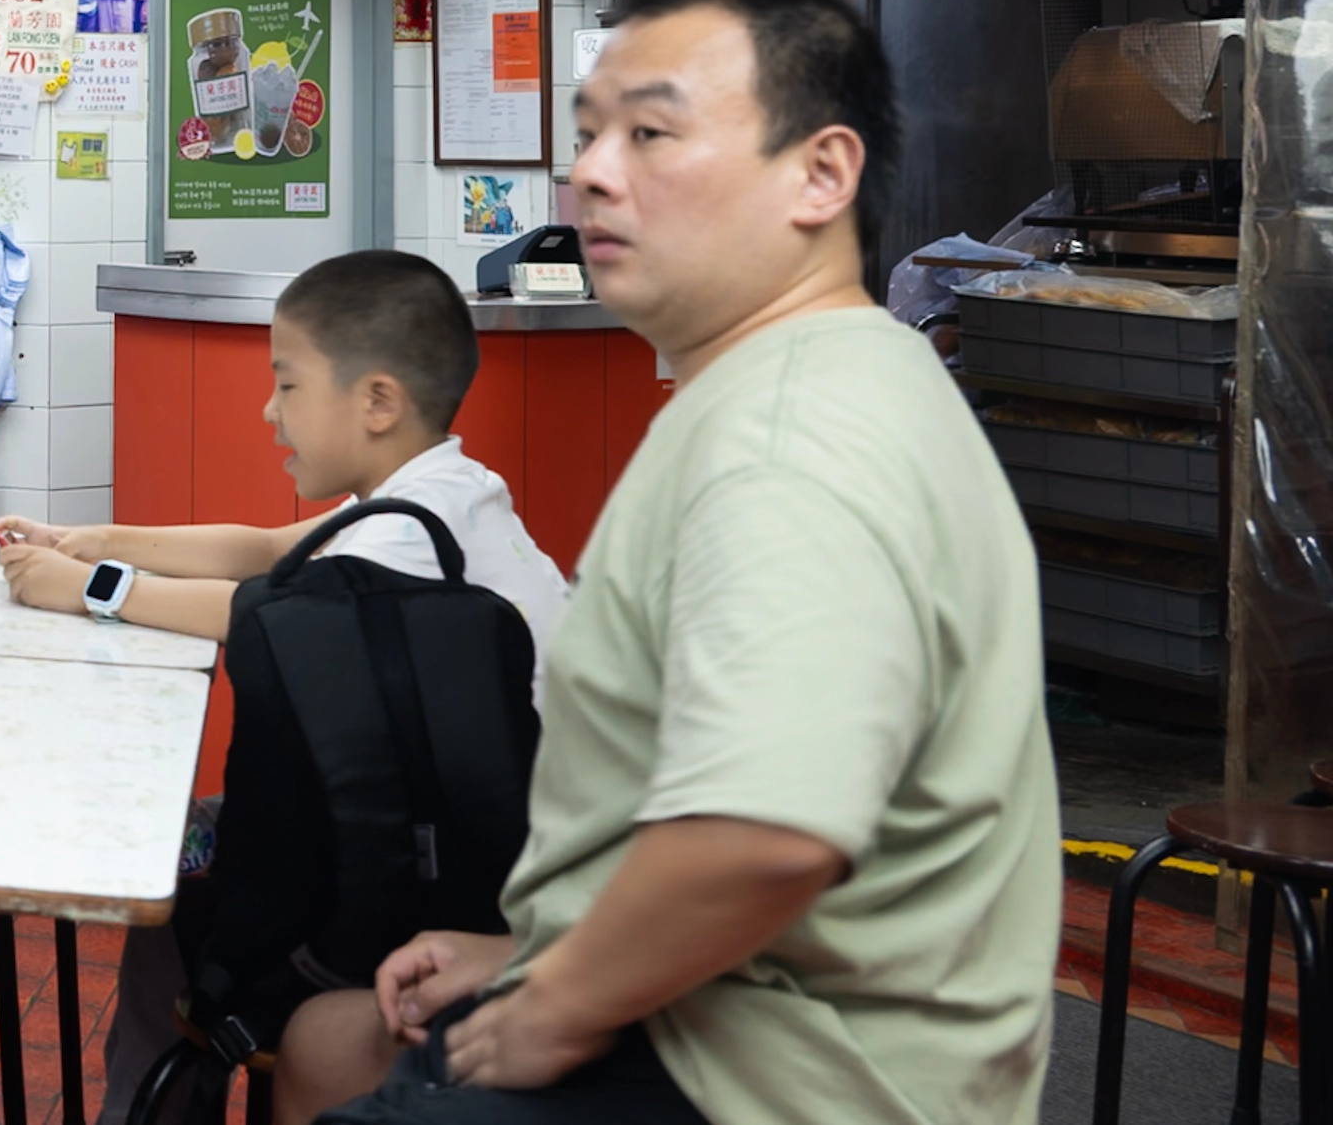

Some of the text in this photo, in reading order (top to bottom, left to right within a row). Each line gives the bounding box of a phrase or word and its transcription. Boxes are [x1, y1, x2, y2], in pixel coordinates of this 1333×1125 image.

[8, 10, 62, 29] 蘭芳園
[6, 50, 35, 74] 70
